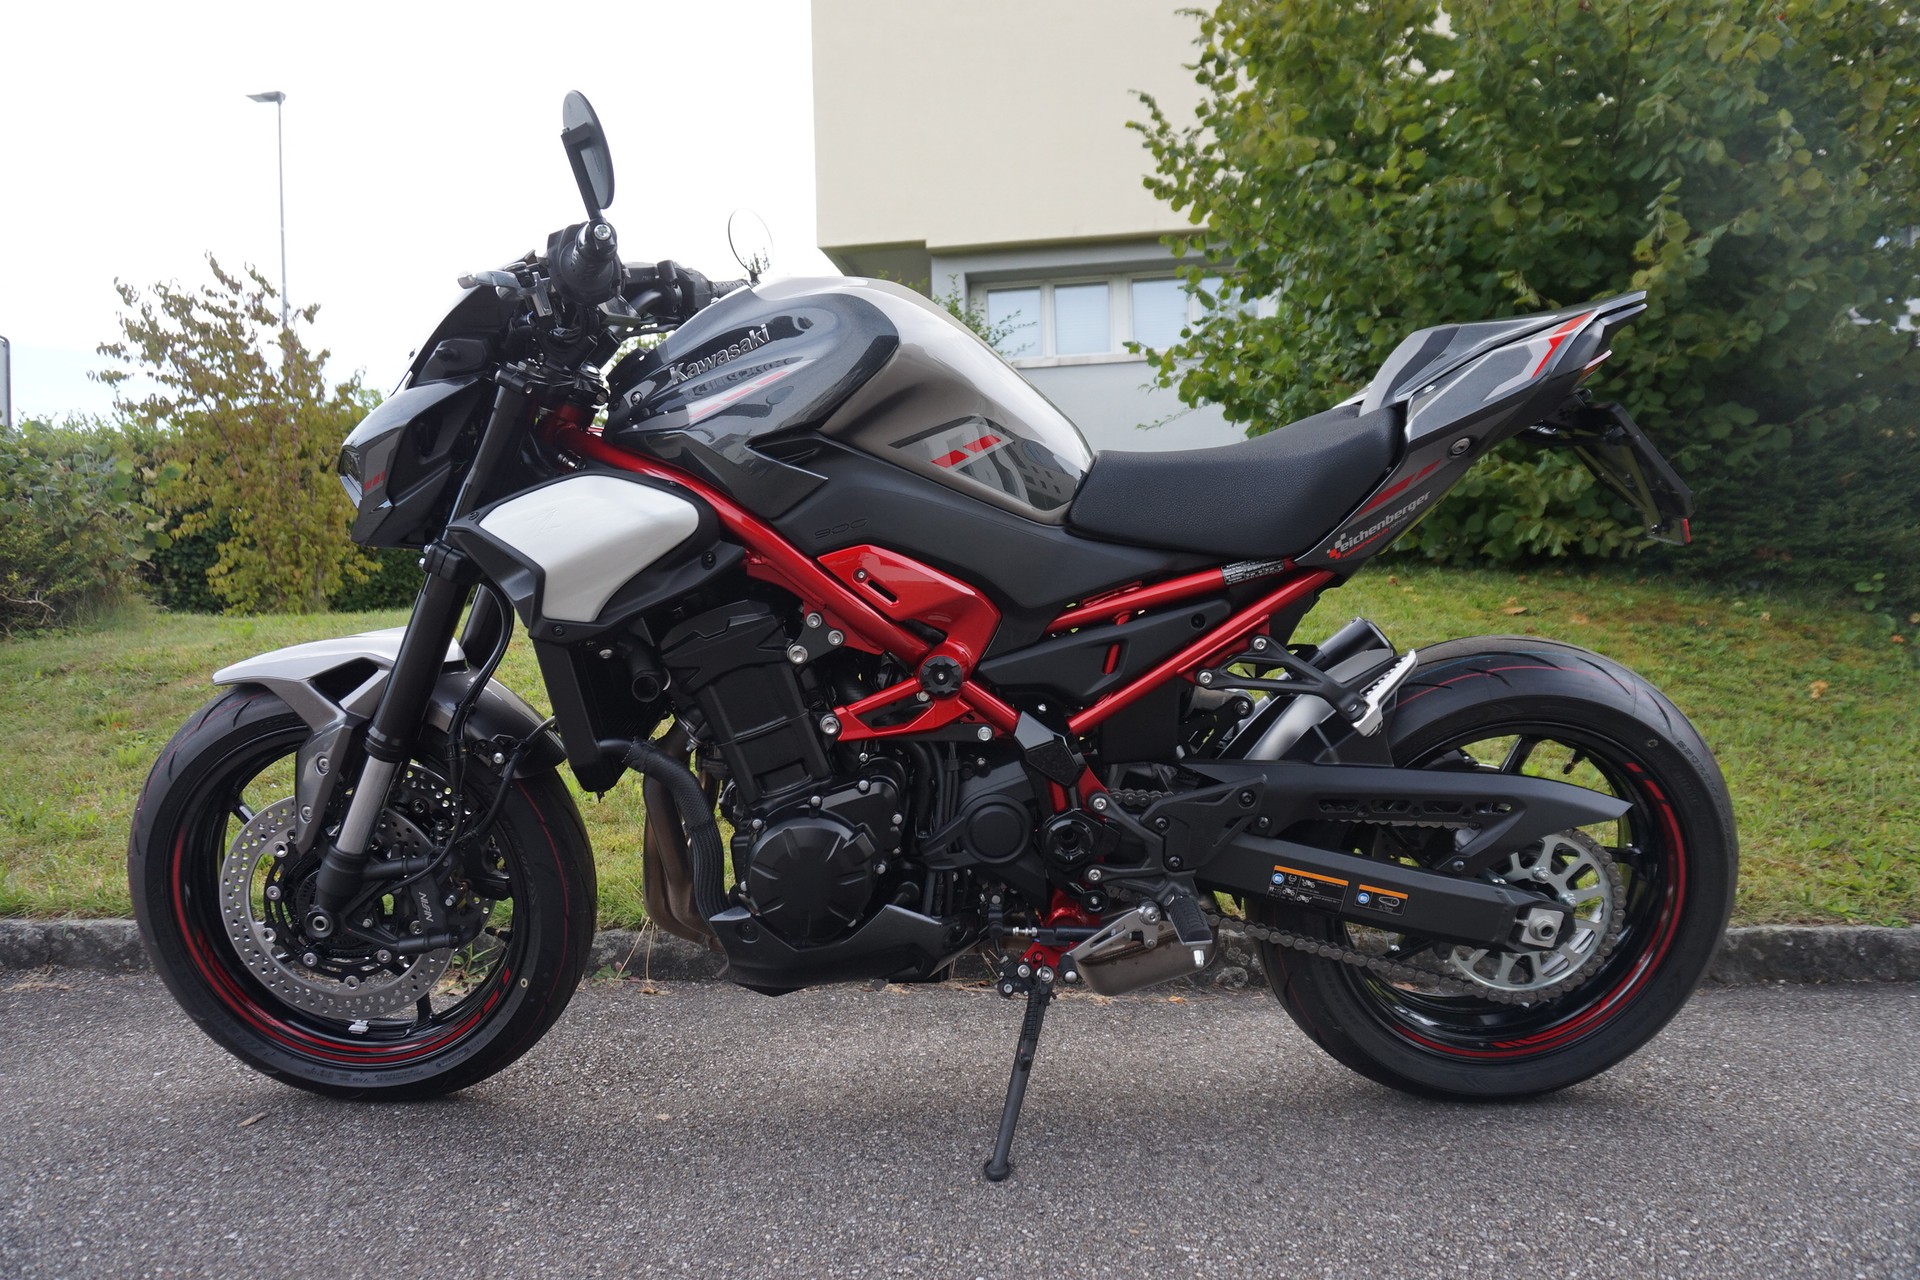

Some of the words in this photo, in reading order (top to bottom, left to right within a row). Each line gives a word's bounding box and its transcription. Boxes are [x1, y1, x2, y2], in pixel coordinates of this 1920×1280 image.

[670, 324, 770, 386] Kawasaki
[814, 518, 868, 540] 900
[1340, 491, 1431, 553] eichenberger
